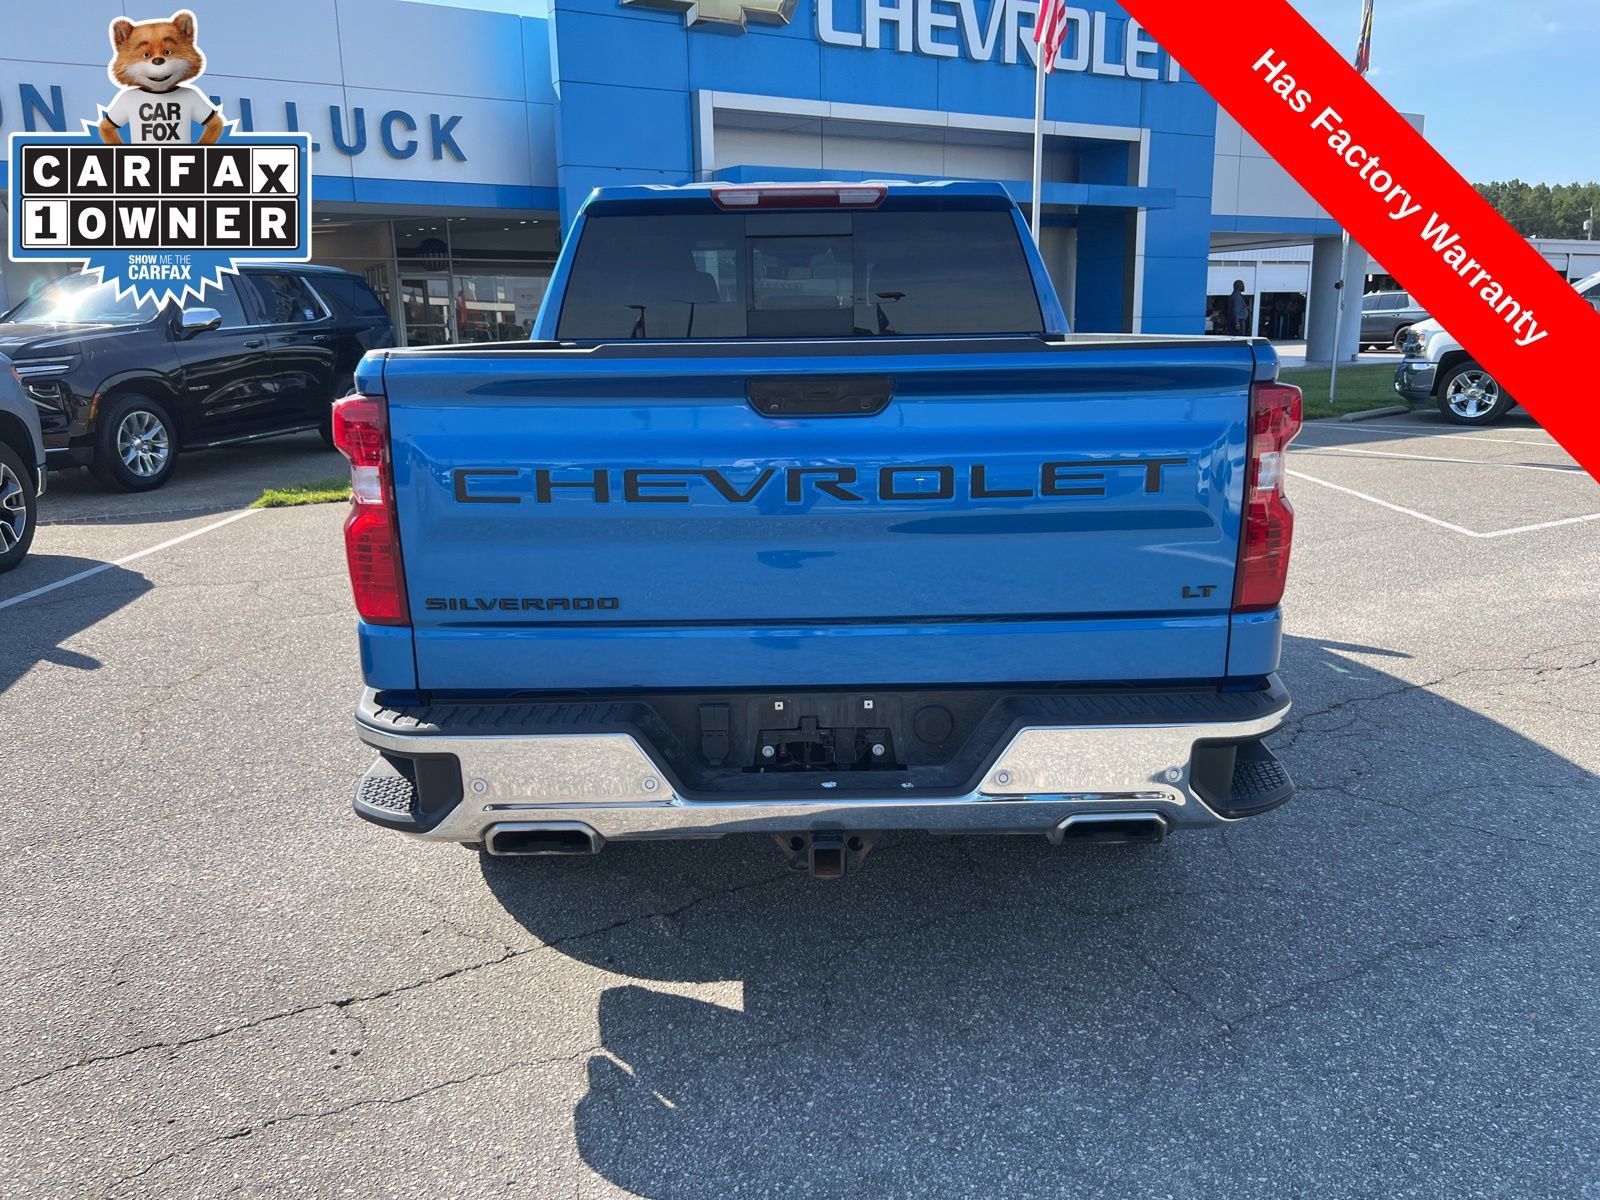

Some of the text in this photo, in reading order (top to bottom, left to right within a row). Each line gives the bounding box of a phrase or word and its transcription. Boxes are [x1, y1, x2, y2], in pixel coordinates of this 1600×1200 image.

[817, 0, 1181, 82] CHEVROLE
[453, 458, 1188, 504] CHEVROLET
[425, 597, 619, 611] SILVERADO
[1182, 584, 1217, 599] LT
